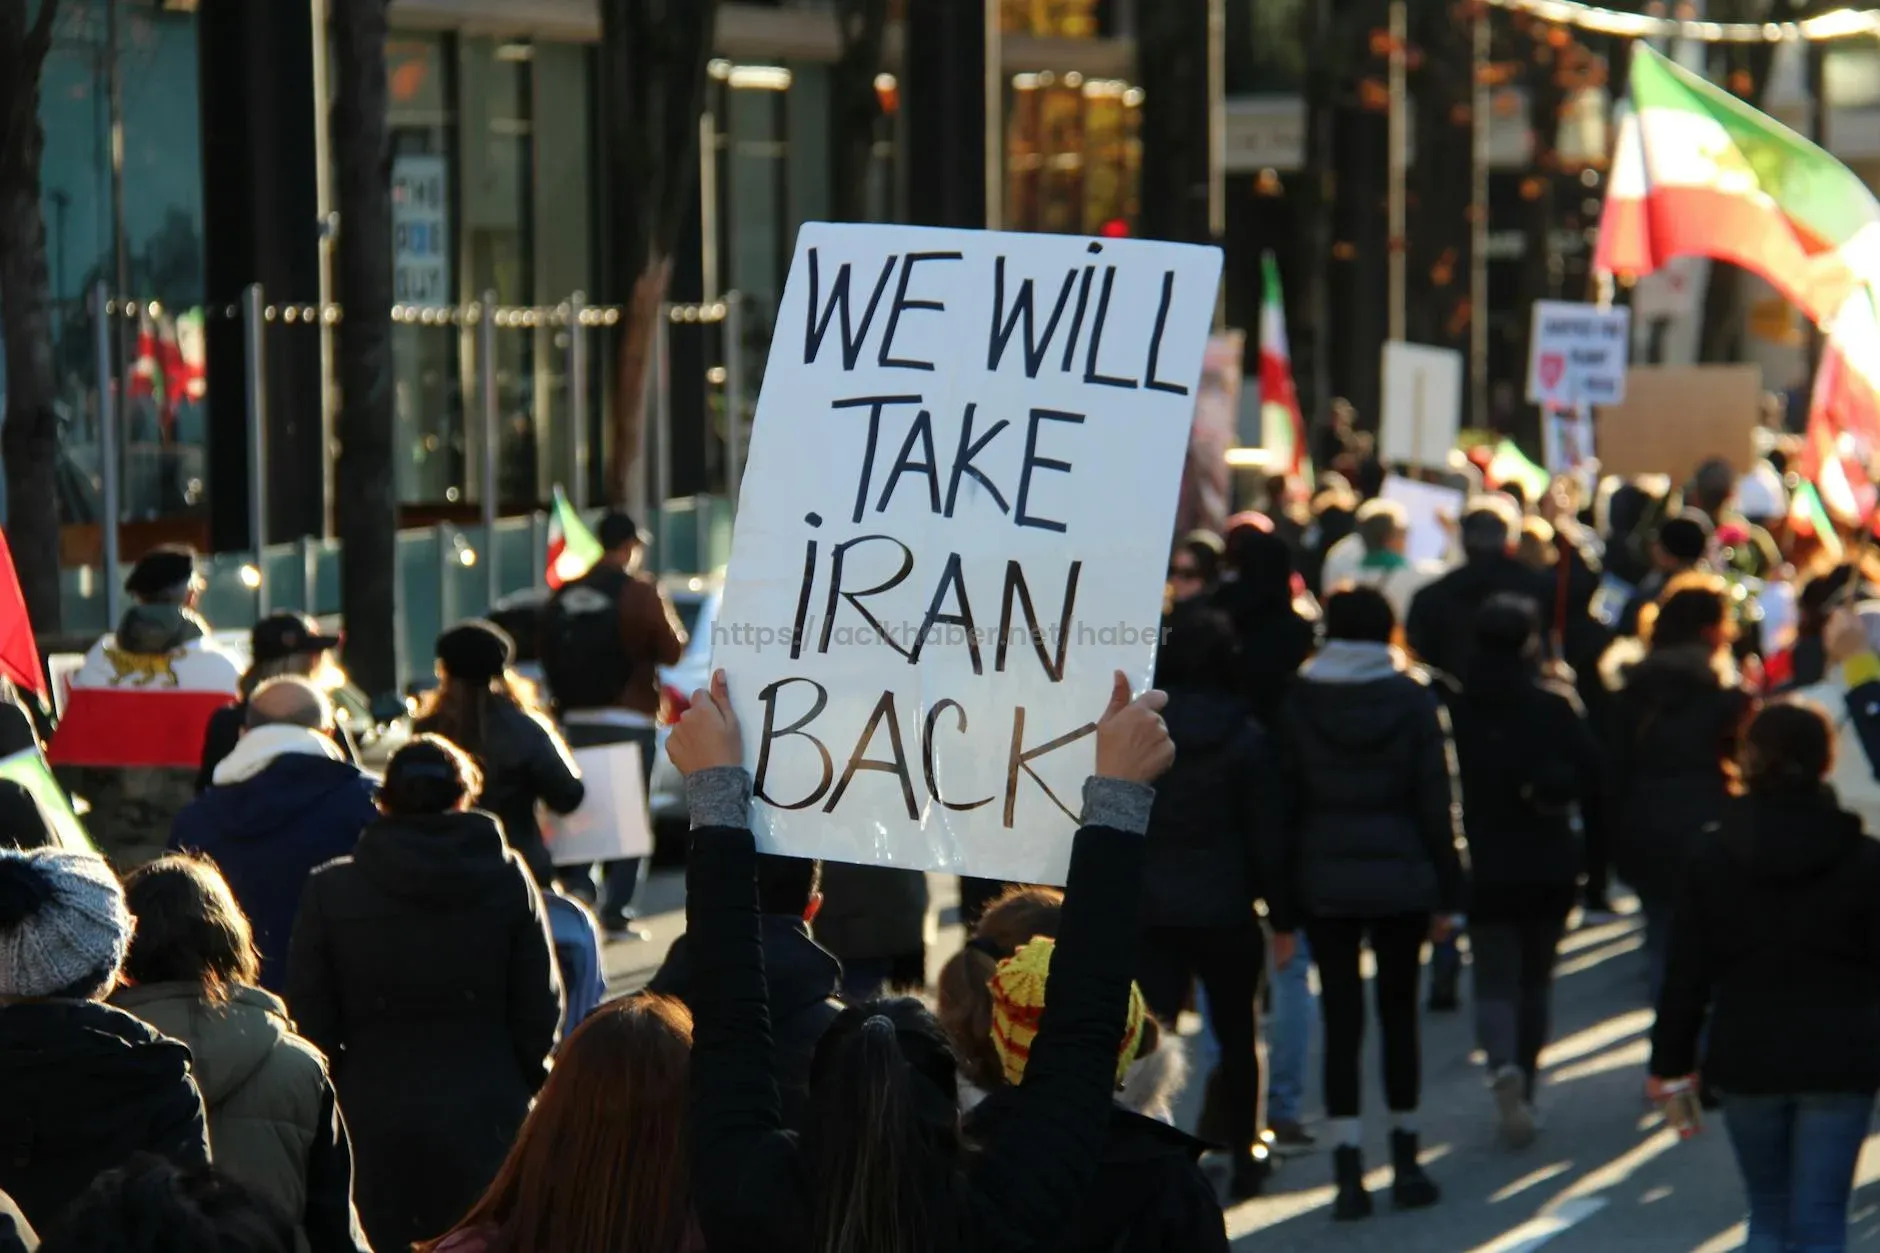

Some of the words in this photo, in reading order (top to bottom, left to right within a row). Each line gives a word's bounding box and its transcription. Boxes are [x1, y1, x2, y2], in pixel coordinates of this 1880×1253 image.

[803, 247, 963, 371] WE
[831, 394, 1086, 533] TAKE
[752, 677, 1100, 829] BACK
